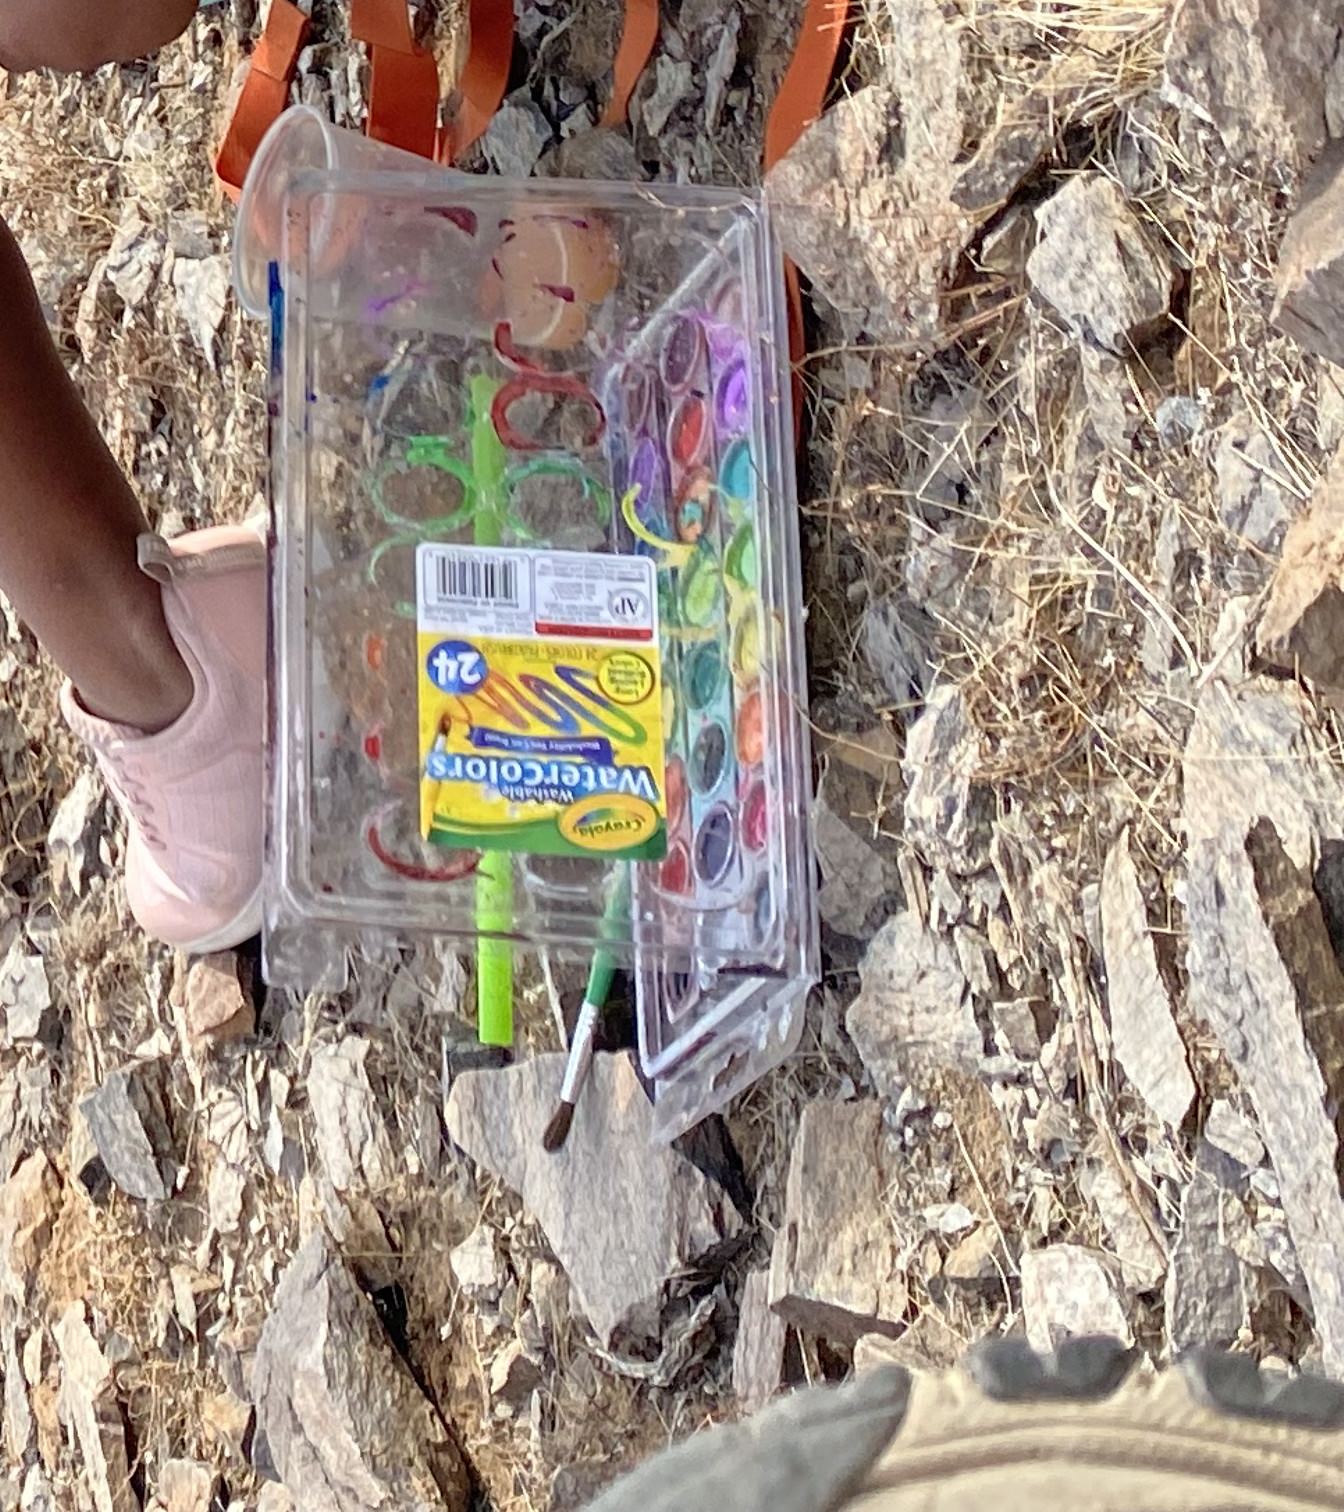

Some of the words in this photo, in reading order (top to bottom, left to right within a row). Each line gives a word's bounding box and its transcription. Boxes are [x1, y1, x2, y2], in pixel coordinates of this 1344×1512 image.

[614, 596, 640, 617] AP
[432, 649, 481, 686] 24
[429, 754, 655, 800] Watercolors
[501, 785, 574, 804] Washable
[573, 816, 646, 838] Crayola
